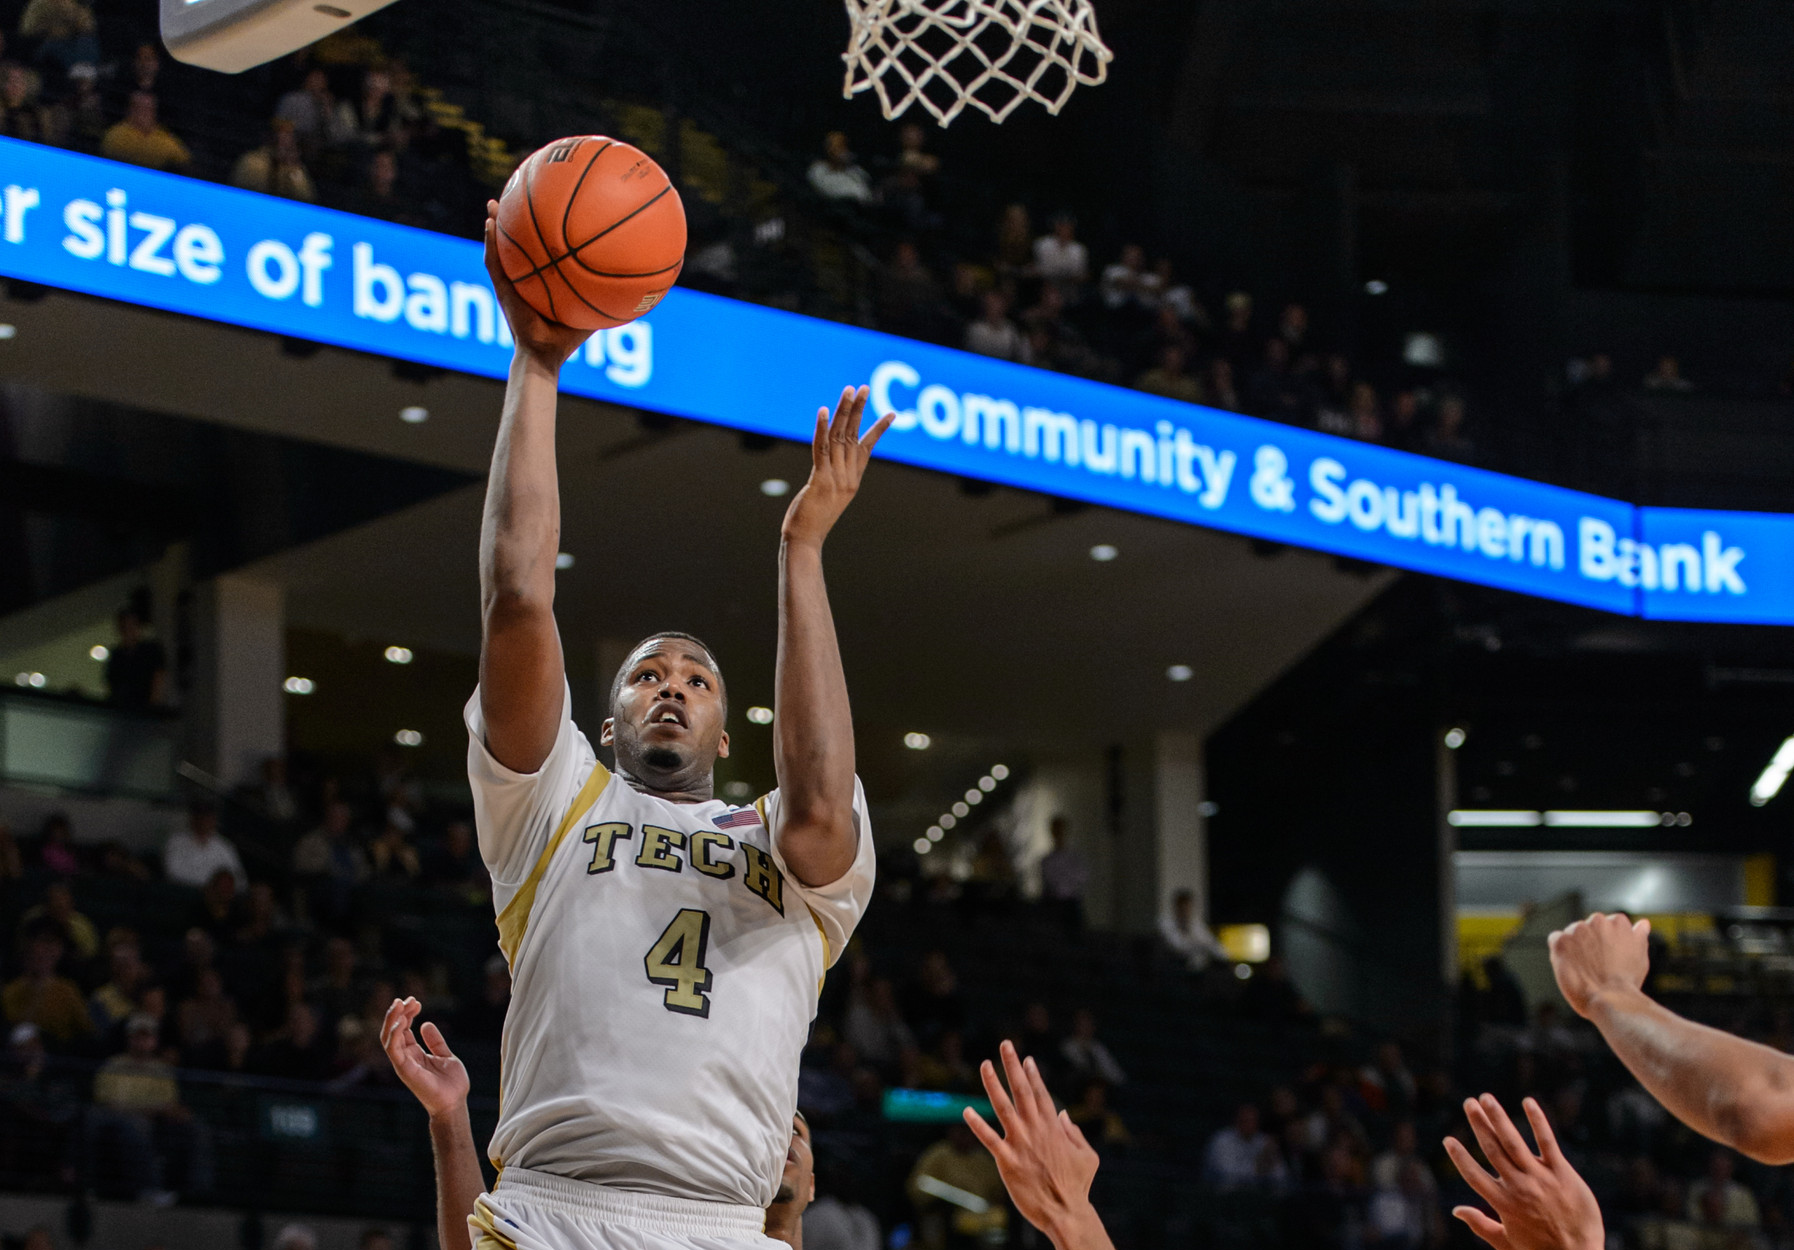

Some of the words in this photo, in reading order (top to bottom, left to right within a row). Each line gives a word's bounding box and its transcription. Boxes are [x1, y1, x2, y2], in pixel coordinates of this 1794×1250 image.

[62, 187, 225, 285] size
[246, 231, 332, 306] of
[353, 241, 653, 388] bang
[867, 361, 1236, 508] Community
[1250, 445, 1295, 511] &
[1310, 458, 1565, 569] Southern
[1579, 517, 1746, 595] Bank
[583, 821, 785, 919] TECH
[644, 907, 713, 1019] 4
